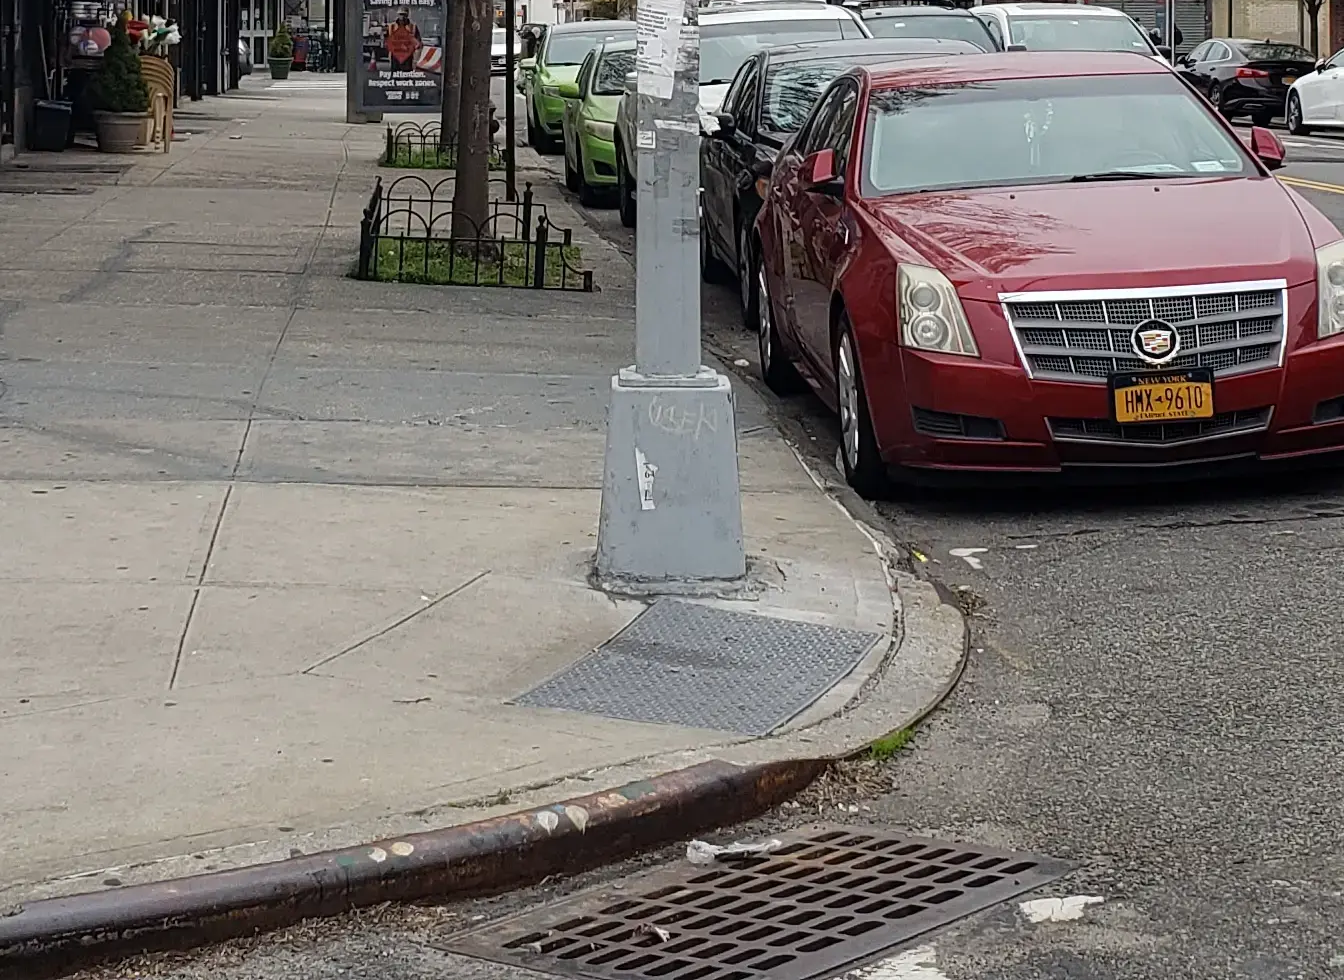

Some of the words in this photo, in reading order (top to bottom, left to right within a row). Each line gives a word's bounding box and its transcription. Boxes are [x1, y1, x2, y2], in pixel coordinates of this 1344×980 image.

[379, 70, 391, 79] Pay
[392, 69, 426, 78] attention.
[368, 79, 395, 87] Respect
[395, 79, 413, 87] work
[414, 79, 437, 87] zones.
[1138, 376, 1160, 385] NEW
[1162, 374, 1187, 383] YORK
